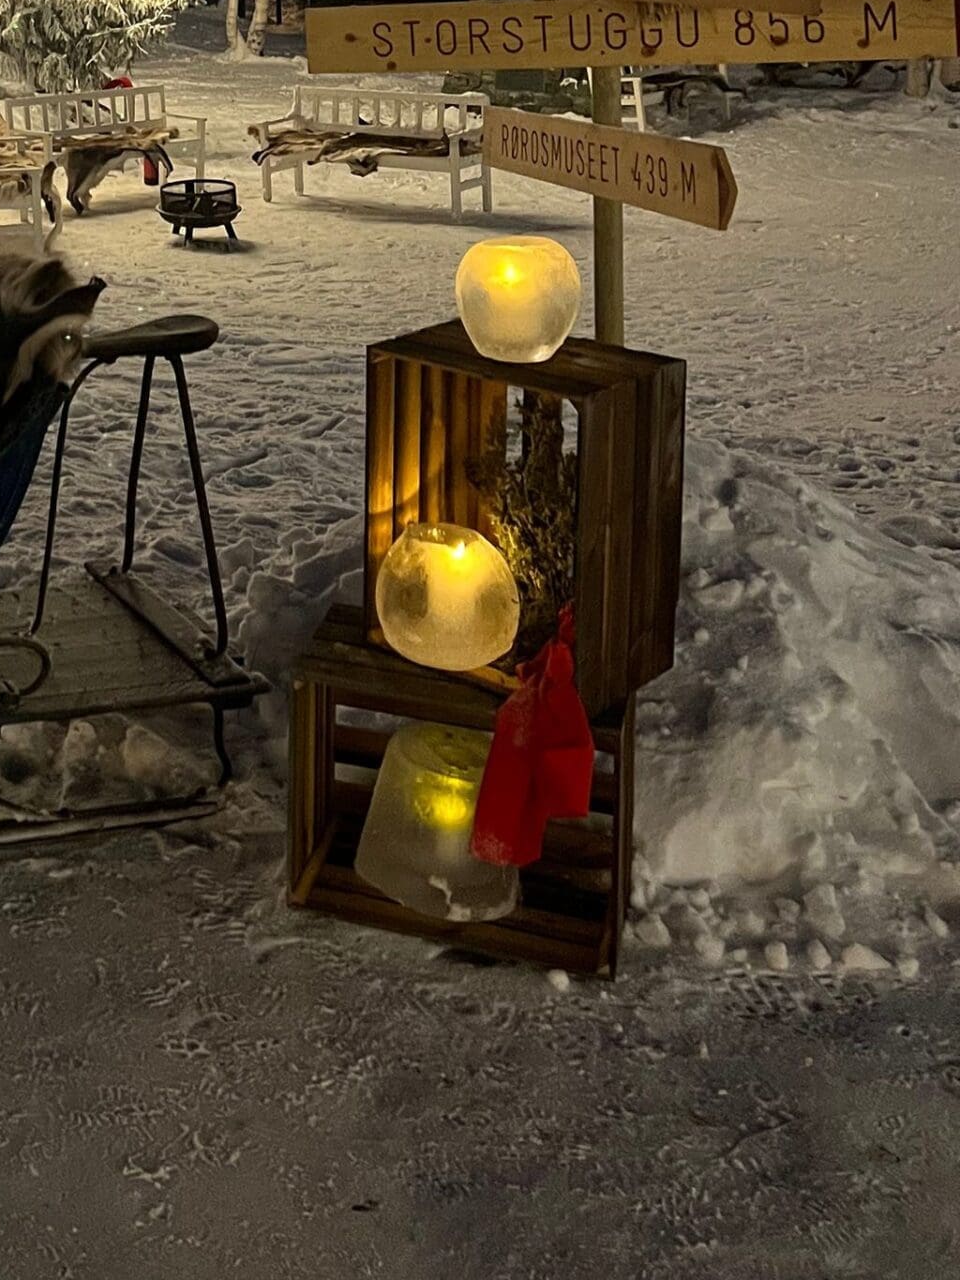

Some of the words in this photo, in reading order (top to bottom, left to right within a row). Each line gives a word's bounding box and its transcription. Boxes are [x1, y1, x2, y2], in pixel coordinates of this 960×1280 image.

[372, 9, 700, 58] STORSTUGGU
[734, 8, 825, 46] 856
[863, 0, 898, 42] M
[501, 124, 620, 186] RØROSMUSEET
[632, 152, 668, 198] 439
[681, 161, 696, 205] M
